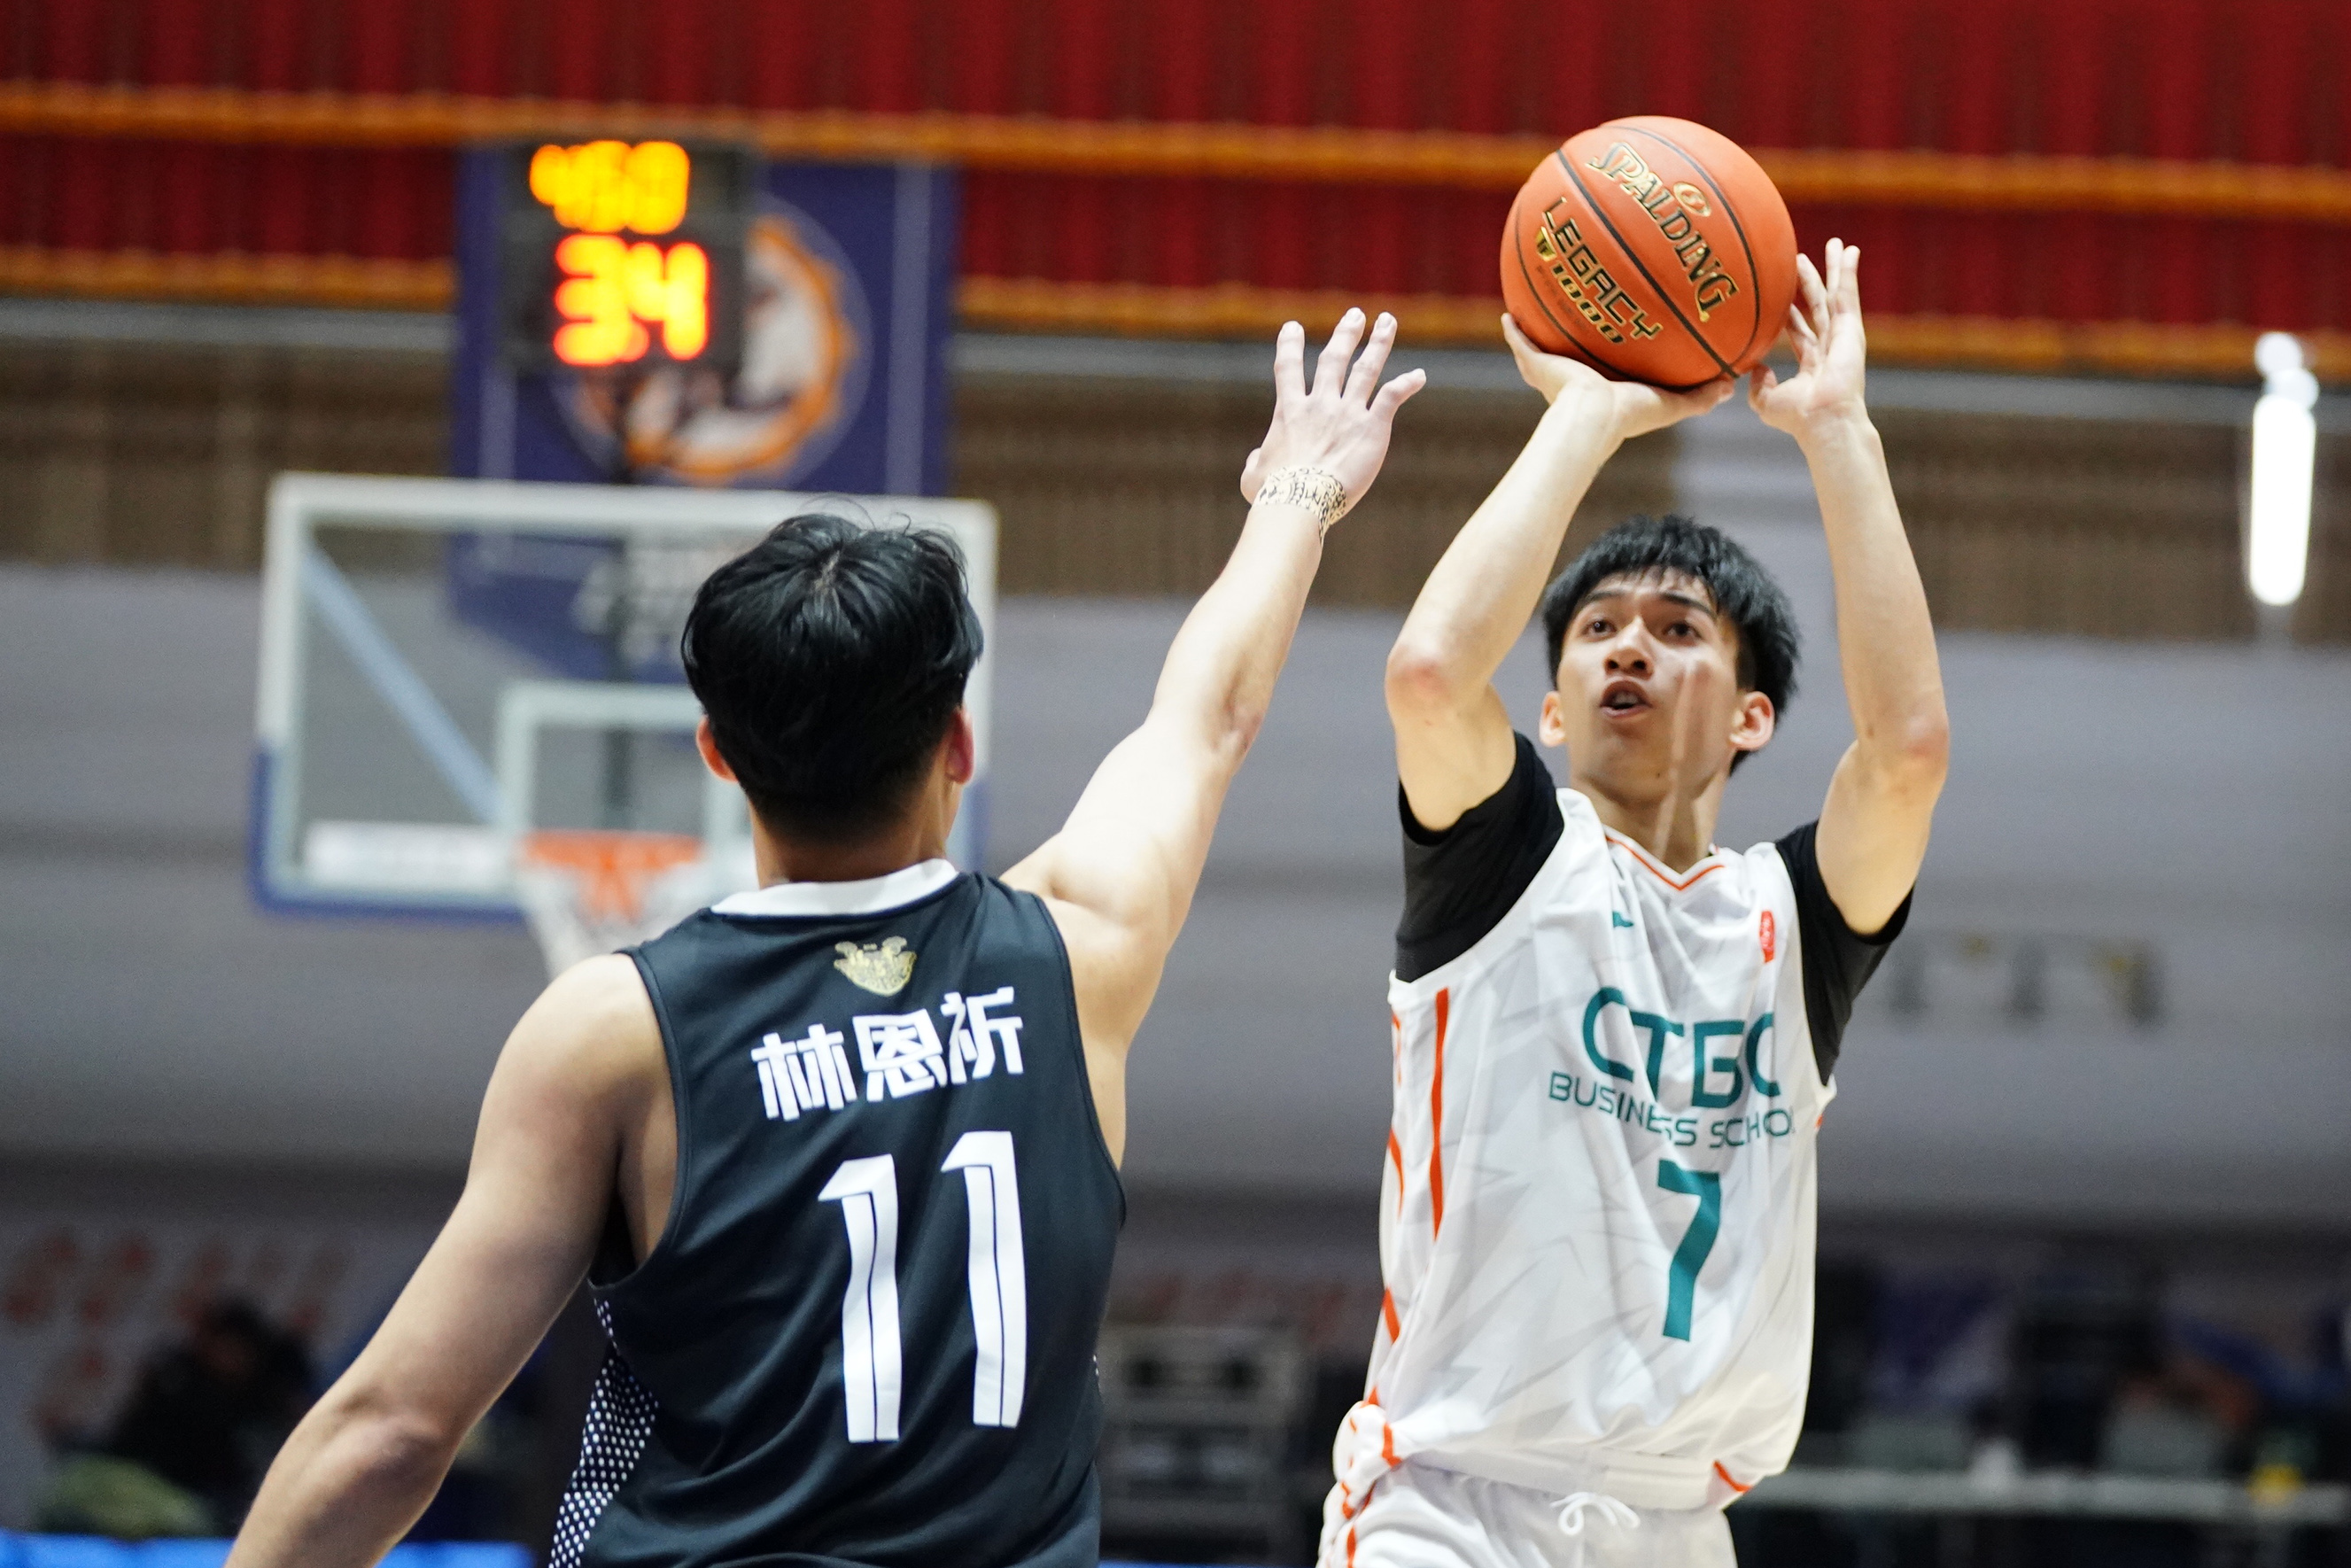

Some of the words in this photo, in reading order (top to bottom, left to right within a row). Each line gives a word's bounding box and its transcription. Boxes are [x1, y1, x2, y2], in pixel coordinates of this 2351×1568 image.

[1541, 196, 1664, 340] LEGACY
[1585, 141, 1739, 322] SPALDING
[750, 986, 1024, 1121] 林恩祈
[817, 1130, 1028, 1443] 11
[1657, 1158, 1721, 1341] 7
